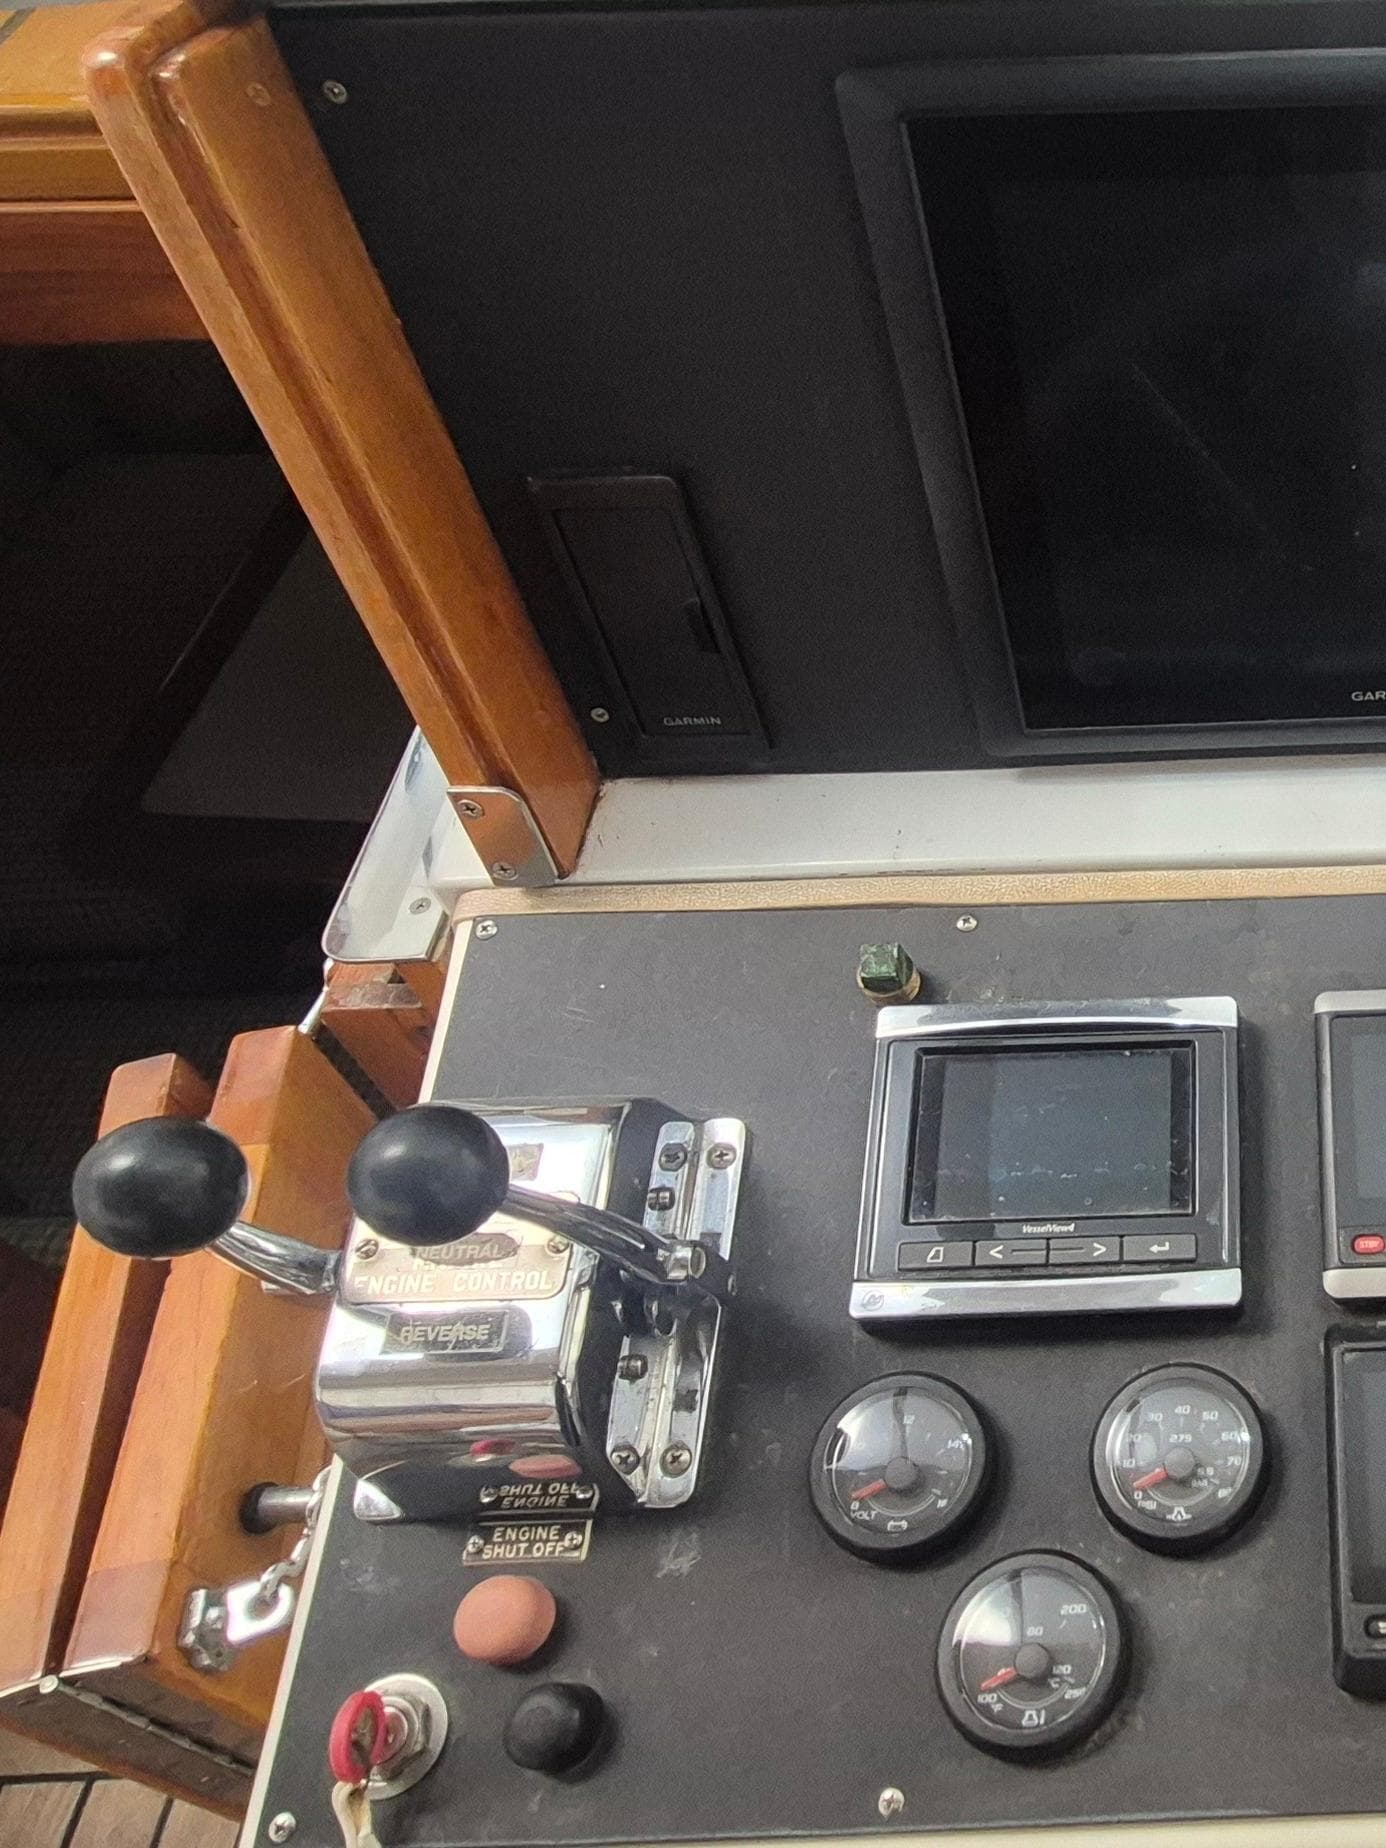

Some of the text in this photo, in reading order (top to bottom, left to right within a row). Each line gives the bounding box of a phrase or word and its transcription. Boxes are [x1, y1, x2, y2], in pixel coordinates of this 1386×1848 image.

[663, 716, 721, 726] GARMIN
[415, 1242, 502, 1261] NEUTRAL
[354, 1269, 553, 1295] ENGINE CONTROL
[400, 1322, 492, 1344] REVERSE
[850, 1511, 878, 1520] VOLT
[492, 1526, 561, 1542] ENGINE
[482, 1542, 566, 1559] SHUT OFF
[1060, 1603, 1087, 1615] 200
[977, 1693, 998, 1703] 100
